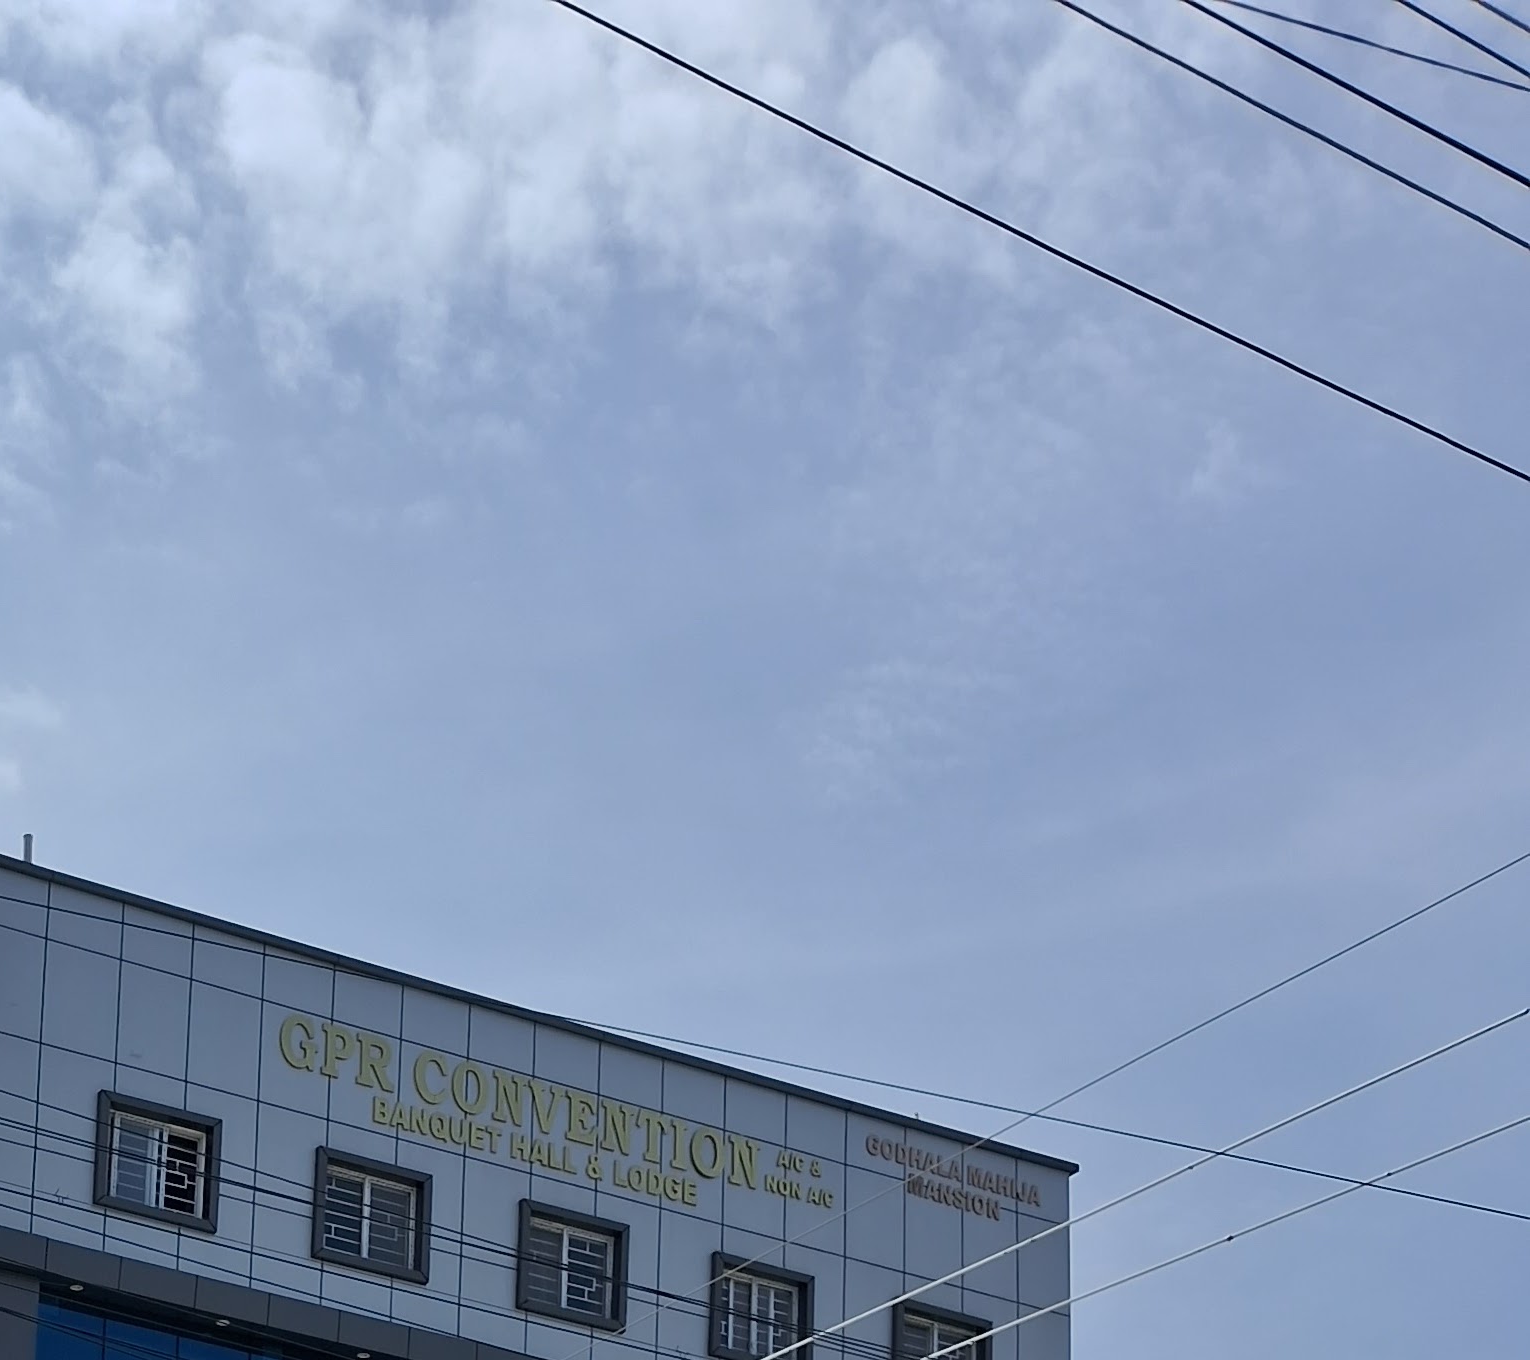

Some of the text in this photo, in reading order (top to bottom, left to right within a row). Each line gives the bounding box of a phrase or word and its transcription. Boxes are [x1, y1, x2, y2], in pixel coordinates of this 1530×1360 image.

[280, 1013, 760, 1190] GPR CONVENTION
[373, 1096, 697, 1206] BANQUET HALL & LODGE
[776, 1150, 821, 1178] A/C &
[764, 1174, 834, 1208] NON A/C
[906, 1173, 1001, 1221] MANSION
